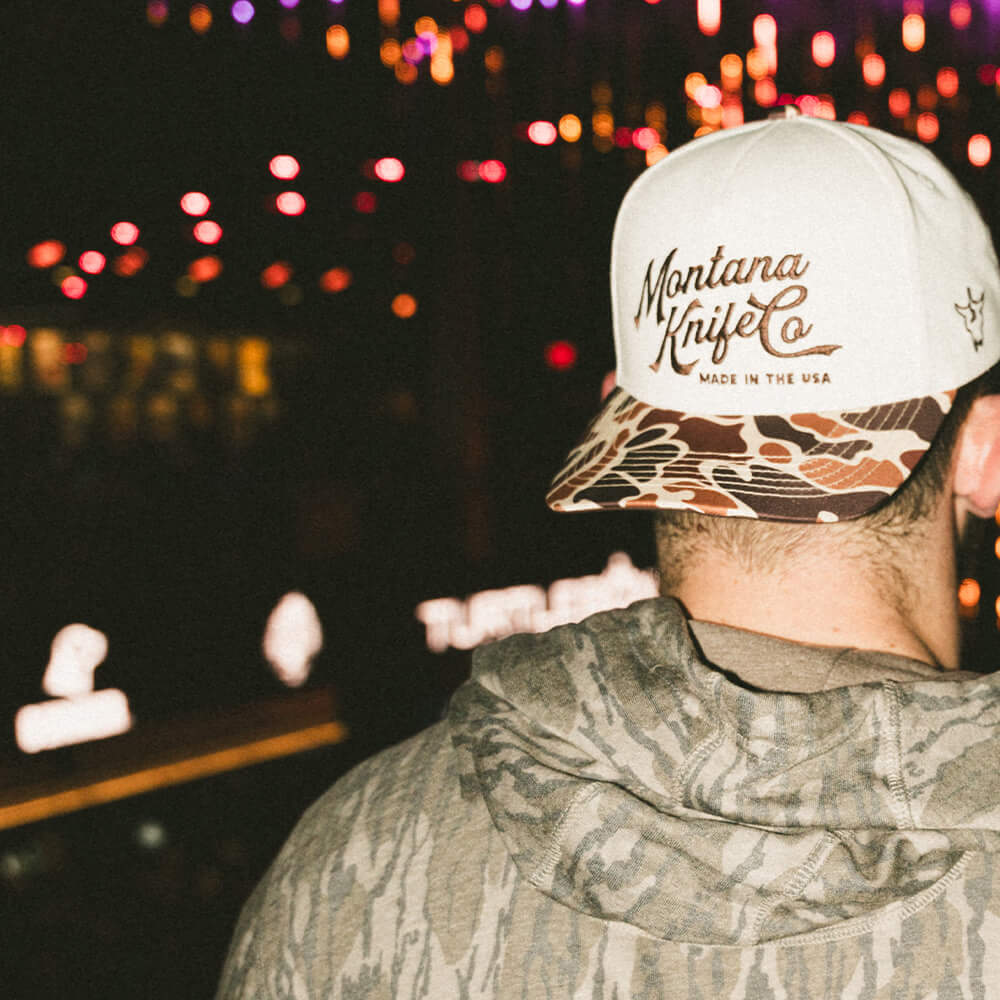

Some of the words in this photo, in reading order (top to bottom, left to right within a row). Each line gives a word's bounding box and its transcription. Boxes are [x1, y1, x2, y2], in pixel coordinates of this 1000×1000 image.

[634, 245, 811, 328] Montana
[648, 297, 760, 376] Knife
[699, 373, 737, 385] MADE
[744, 373, 759, 385] IN
[765, 373, 795, 385] THE
[801, 372, 832, 385] USA
